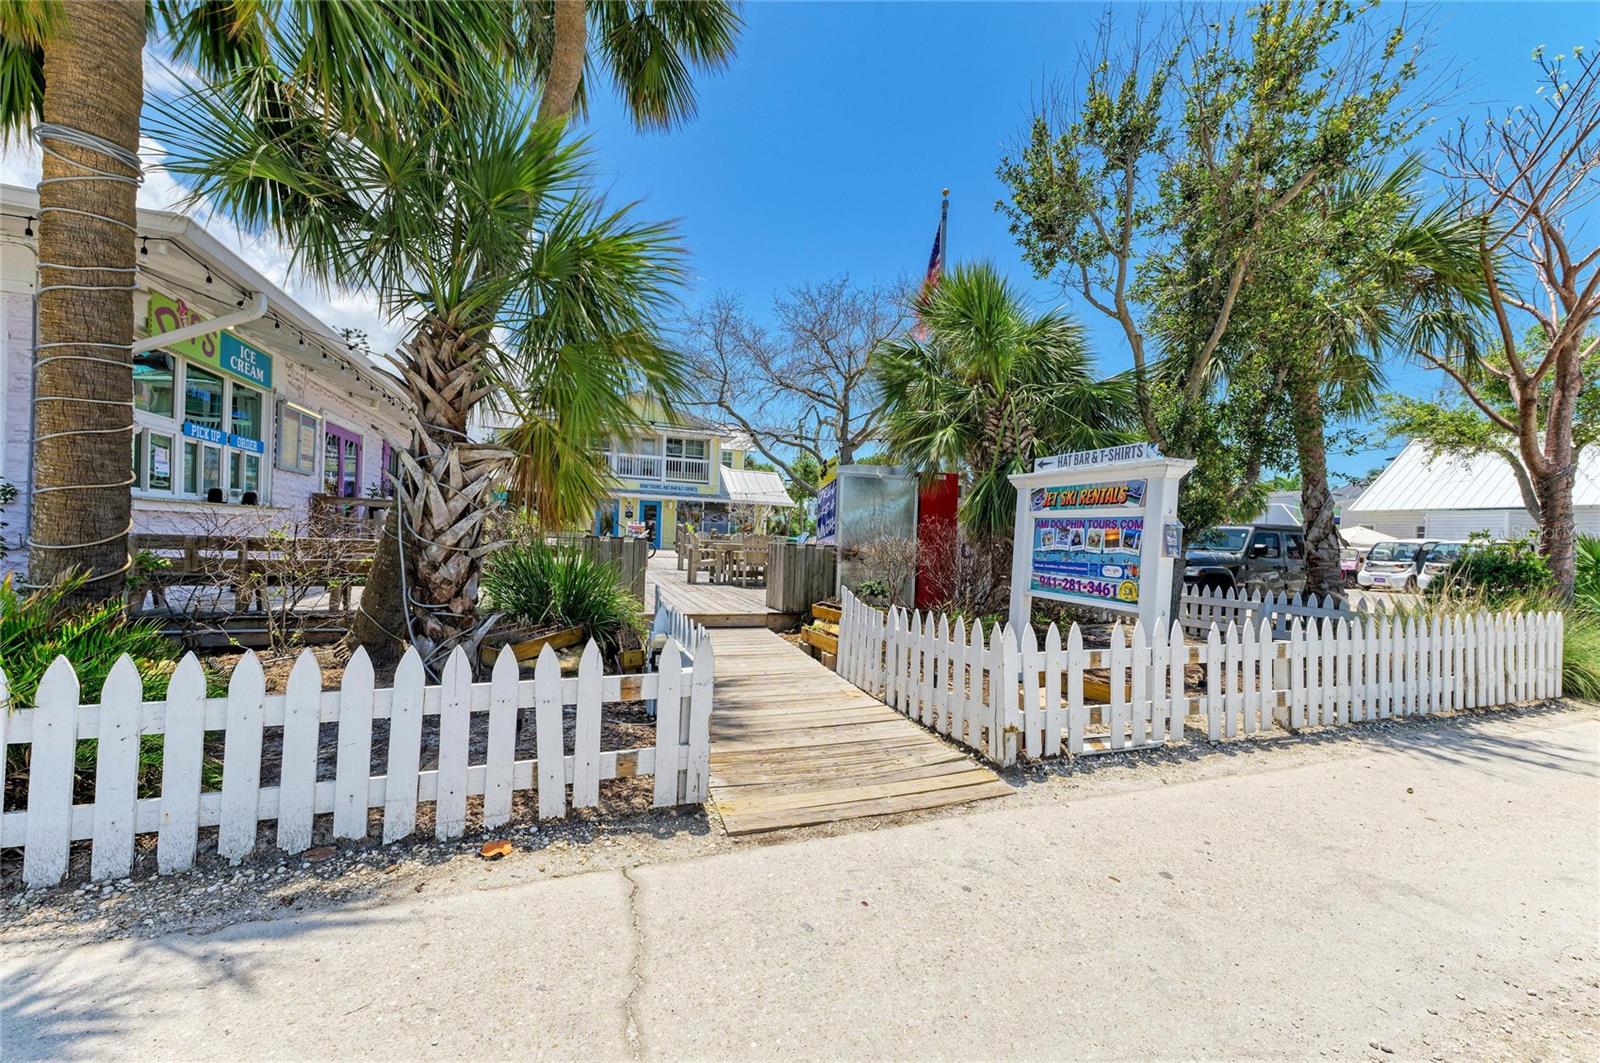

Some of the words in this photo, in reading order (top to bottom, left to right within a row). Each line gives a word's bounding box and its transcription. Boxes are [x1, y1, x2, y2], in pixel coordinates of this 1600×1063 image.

[240, 345, 256, 365] ICE
[230, 356, 264, 382] CREAM
[191, 424, 209, 440] PICK
[210, 430, 221, 442] UP
[237, 436, 258, 451] ORDER
[1057, 454, 1073, 468] HAT
[1074, 452, 1090, 466] BAR
[1091, 451, 1098, 464] &
[1100, 444, 1143, 463] T-SHIRTS
[1042, 491, 1059, 508] JET
[1060, 489, 1077, 506] SKI
[1078, 486, 1129, 506] RENTALS
[1035, 520, 1050, 529] AMI
[1051, 519, 1085, 529] DOLPHIN
[1039, 575, 1117, 598] 941-281-3461
